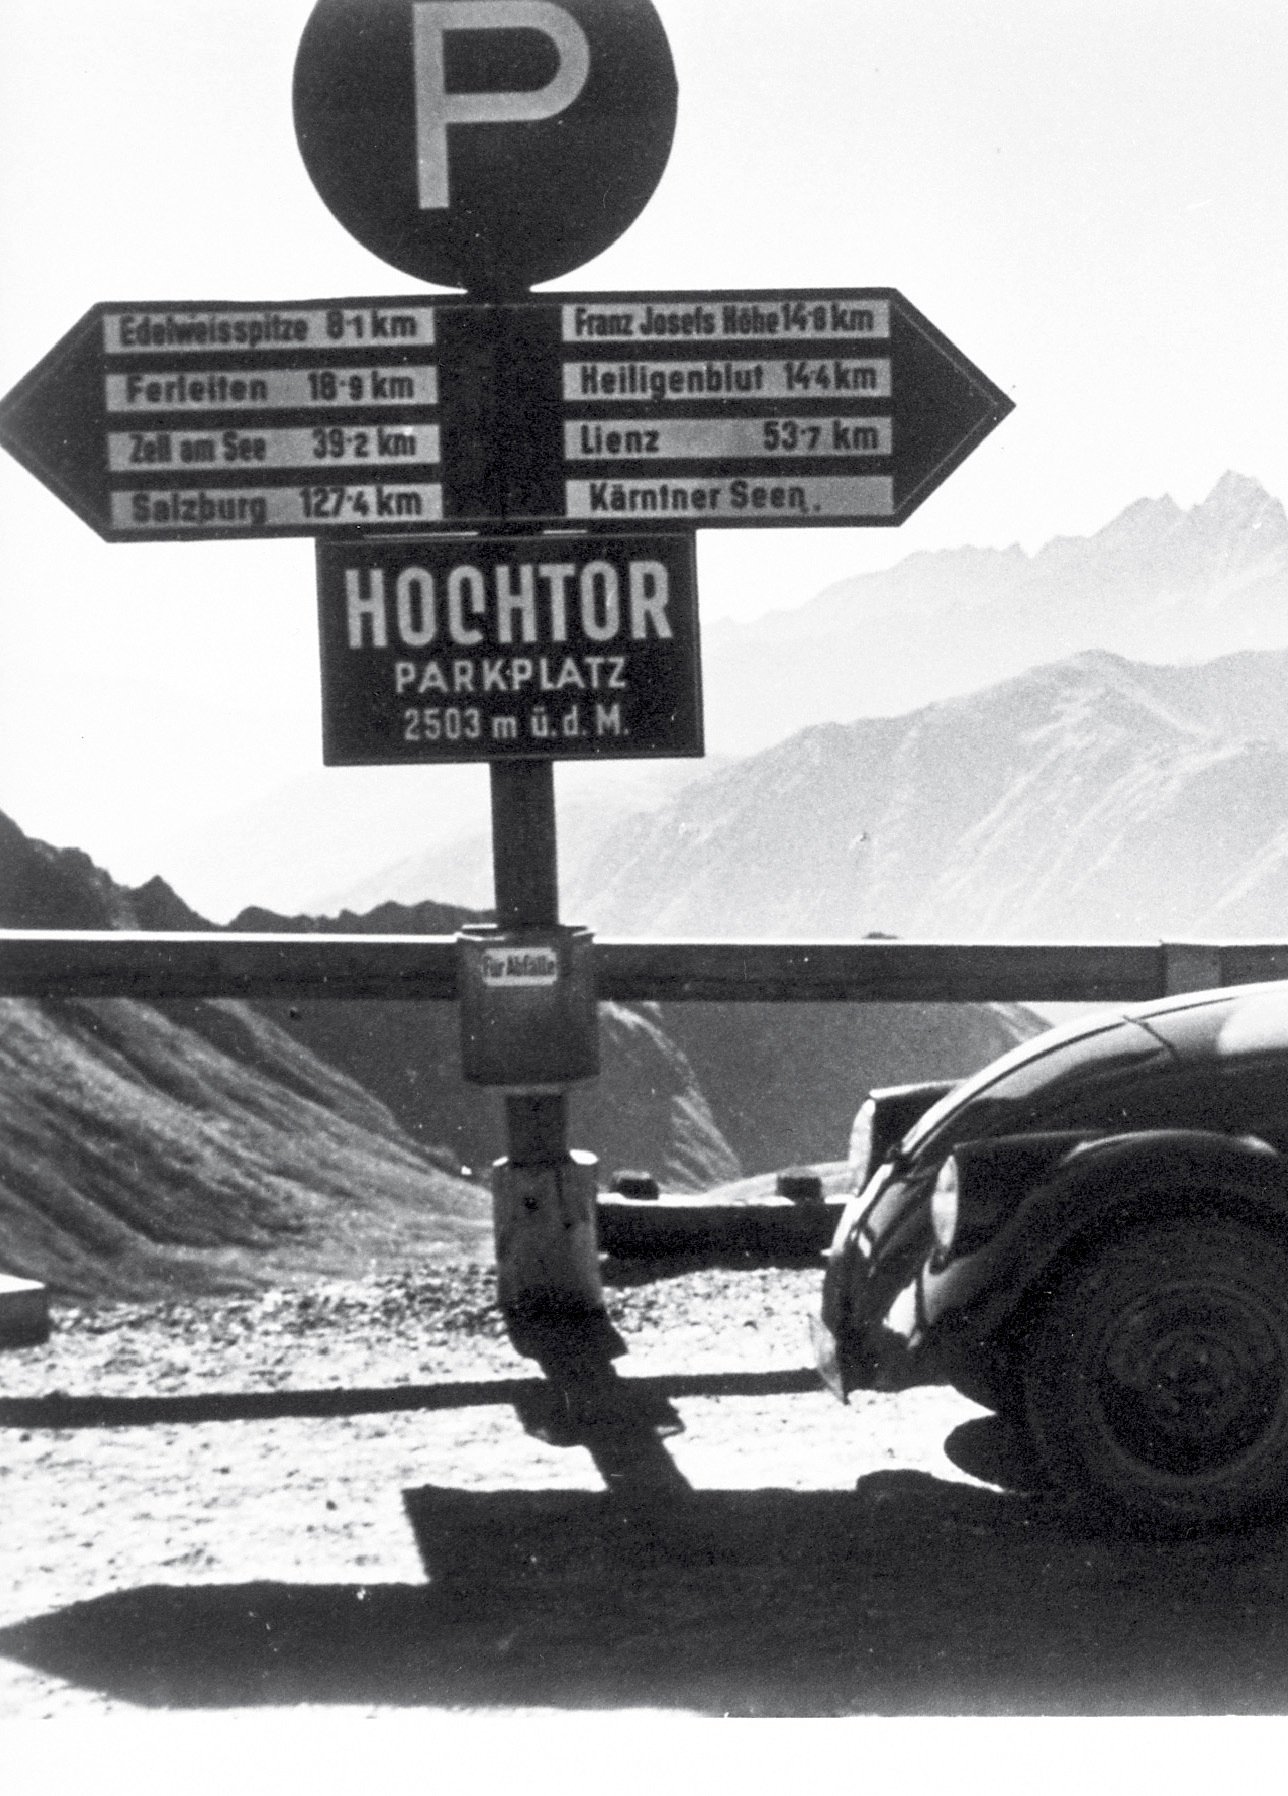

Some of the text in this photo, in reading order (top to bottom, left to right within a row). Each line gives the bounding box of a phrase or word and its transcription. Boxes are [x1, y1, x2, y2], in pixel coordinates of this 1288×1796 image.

[413, 3, 590, 209] P
[120, 313, 308, 348] Edelweisspitze
[371, 309, 417, 338] km
[574, 307, 634, 336] Franz
[639, 306, 715, 336] Josefs
[722, 304, 779, 334] Höhe
[831, 302, 874, 331] km
[125, 374, 268, 403] Ferleiten
[371, 371, 414, 400] km
[580, 361, 764, 400] Heiligenblut
[834, 361, 877, 389] km
[130, 433, 172, 463] Zell
[179, 437, 216, 463] am
[222, 430, 267, 462] See
[376, 427, 417, 456] km
[580, 424, 660, 454] Lienz
[833, 420, 879, 450] km
[132, 492, 267, 524] Salzburg
[375, 487, 422, 516] km
[589, 481, 721, 512] Kärntner
[345, 560, 674, 650] HOCHTOR
[395, 656, 626, 693] PARKPLATZ
[404, 706, 481, 740] 2503
[492, 714, 517, 738] m
